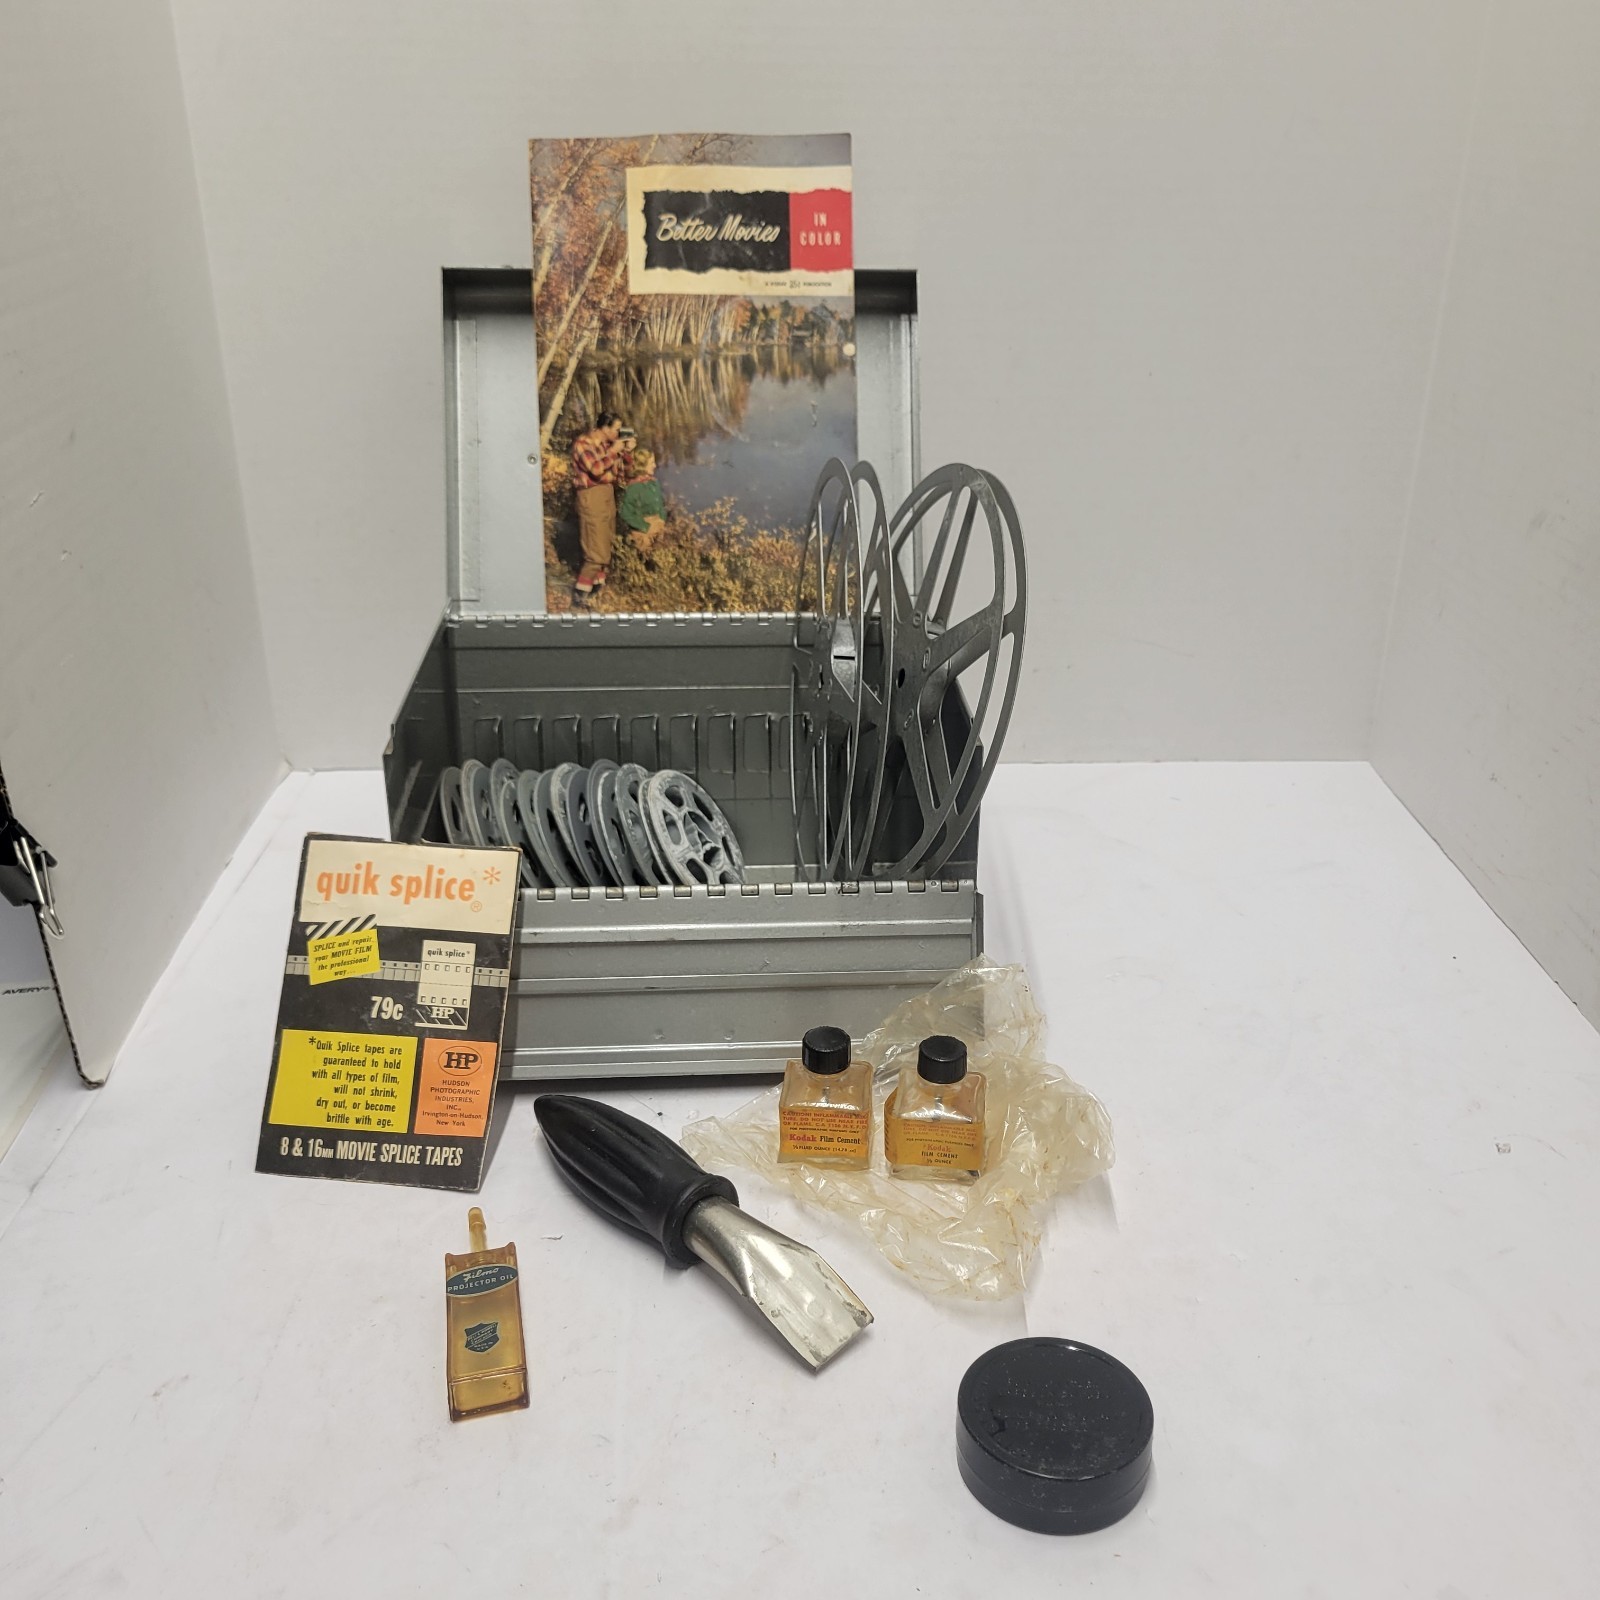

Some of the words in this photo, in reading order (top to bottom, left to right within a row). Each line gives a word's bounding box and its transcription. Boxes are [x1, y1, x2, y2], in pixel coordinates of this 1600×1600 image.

[813, 212, 827, 227] IN
[656, 213, 718, 242] Better
[717, 214, 780, 243] Movies
[800, 231, 841, 246] COLOR
[316, 861, 381, 901] quik
[313, 942, 336, 952] SPLICE
[352, 936, 372, 946] repair
[315, 955, 329, 963] your
[331, 949, 353, 959] MOVIE
[354, 945, 372, 954] FILM
[427, 948, 443, 957] quik
[330, 955, 370, 970] professional
[337, 1041, 360, 1054] Splice
[364, 1044, 385, 1055] tapes
[389, 1047, 402, 1055] are
[323, 1057, 367, 1067] guaranteed
[371, 1059, 379, 1068] to
[383, 1059, 401, 1070] hold
[312, 1069, 328, 1079] with
[331, 1070, 342, 1080] all
[346, 1071, 366, 1083] types
[370, 1073, 378, 1082] of
[382, 1073, 400, 1085] film,
[333, 1085, 348, 1094] will
[353, 1087, 366, 1095] not
[370, 1086, 398, 1099] shrink,
[430, 1087, 480, 1095] PHOTOGRAPHIC
[316, 1096, 329, 1109] dry
[333, 1099, 347, 1110] out,
[352, 1102, 361, 1110] or
[365, 1100, 396, 1112] become
[326, 1112, 350, 1124] brittle
[355, 1114, 372, 1125] with
[376, 1118, 394, 1128] age.
[789, 1133, 817, 1142] Kodak
[819, 1135, 834, 1143] Film
[836, 1136, 860, 1145] Cement
[280, 1136, 289, 1156] 8
[291, 1137, 303, 1157] &
[336, 1140, 378, 1162] MOVIE
[380, 1143, 422, 1164] SPLICE
[425, 1146, 463, 1167] TAPES
[927, 1144, 951, 1153] Kodak
[463, 1267, 499, 1283] Filmo
[447, 1277, 497, 1292] PROJECTOR
